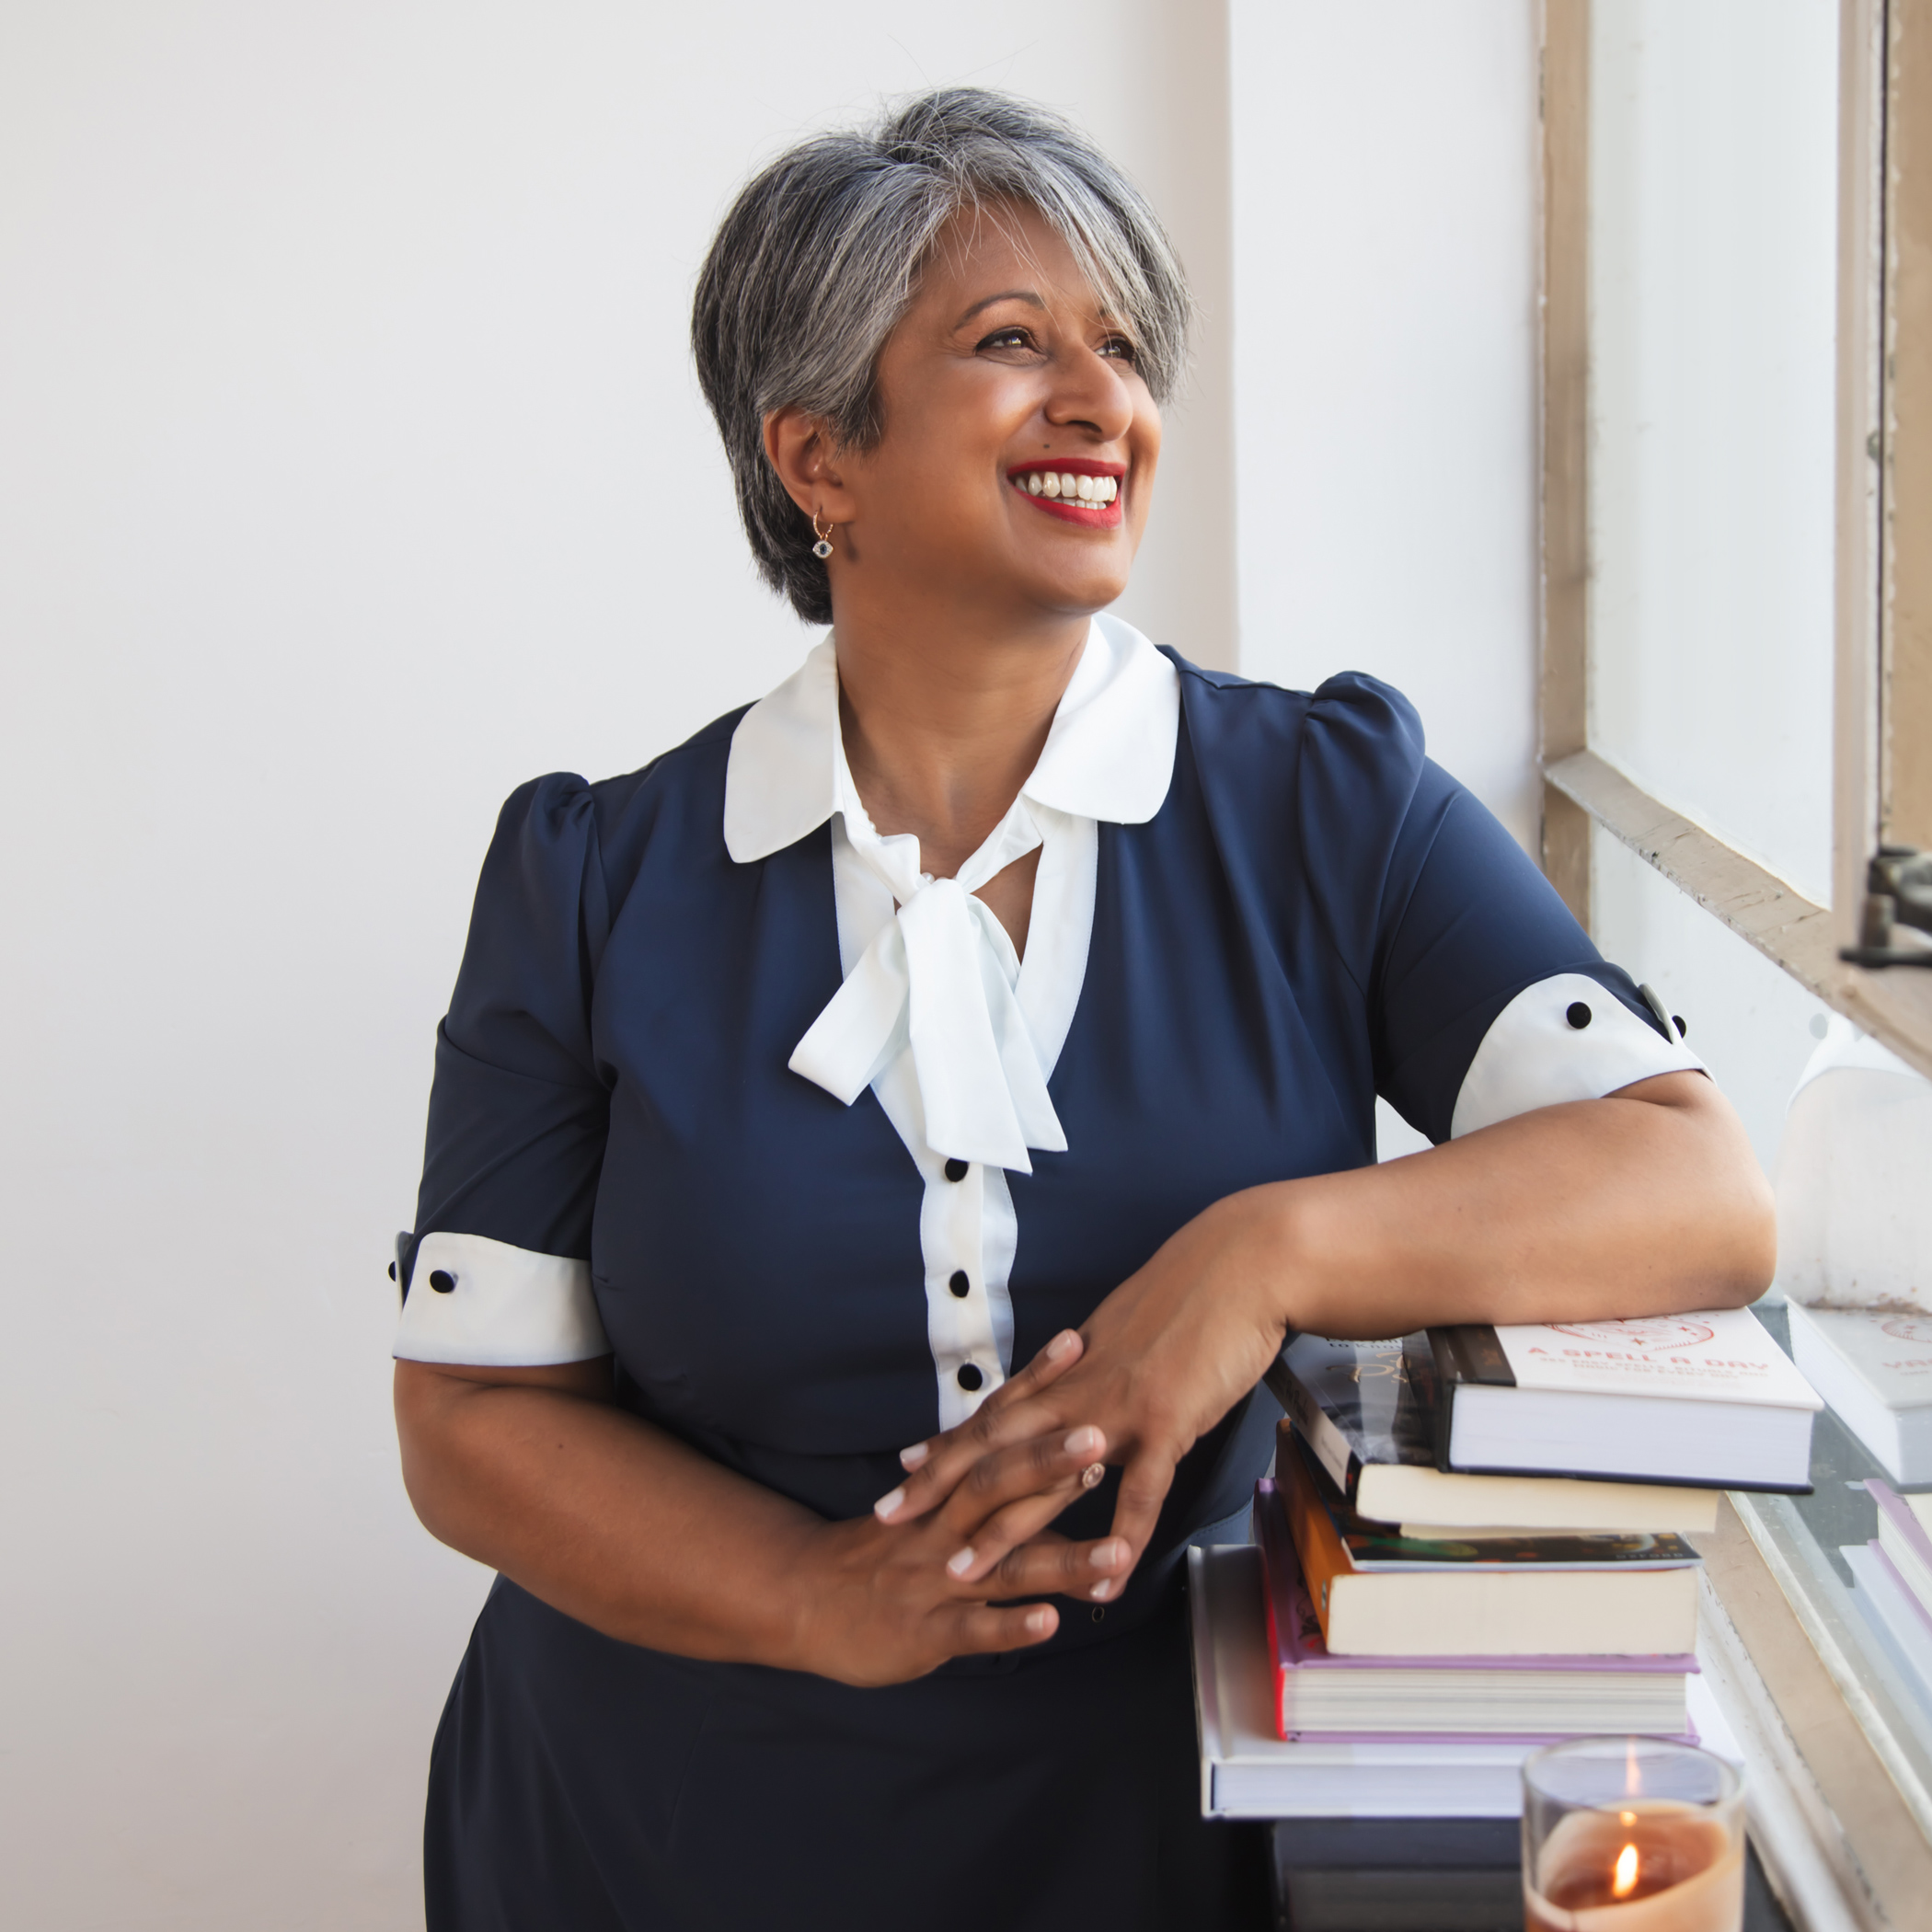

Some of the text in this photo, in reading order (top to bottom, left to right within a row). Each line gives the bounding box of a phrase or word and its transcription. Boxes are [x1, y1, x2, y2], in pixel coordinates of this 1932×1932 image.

[1528, 1347, 1769, 1371] A SPELL A DAY
